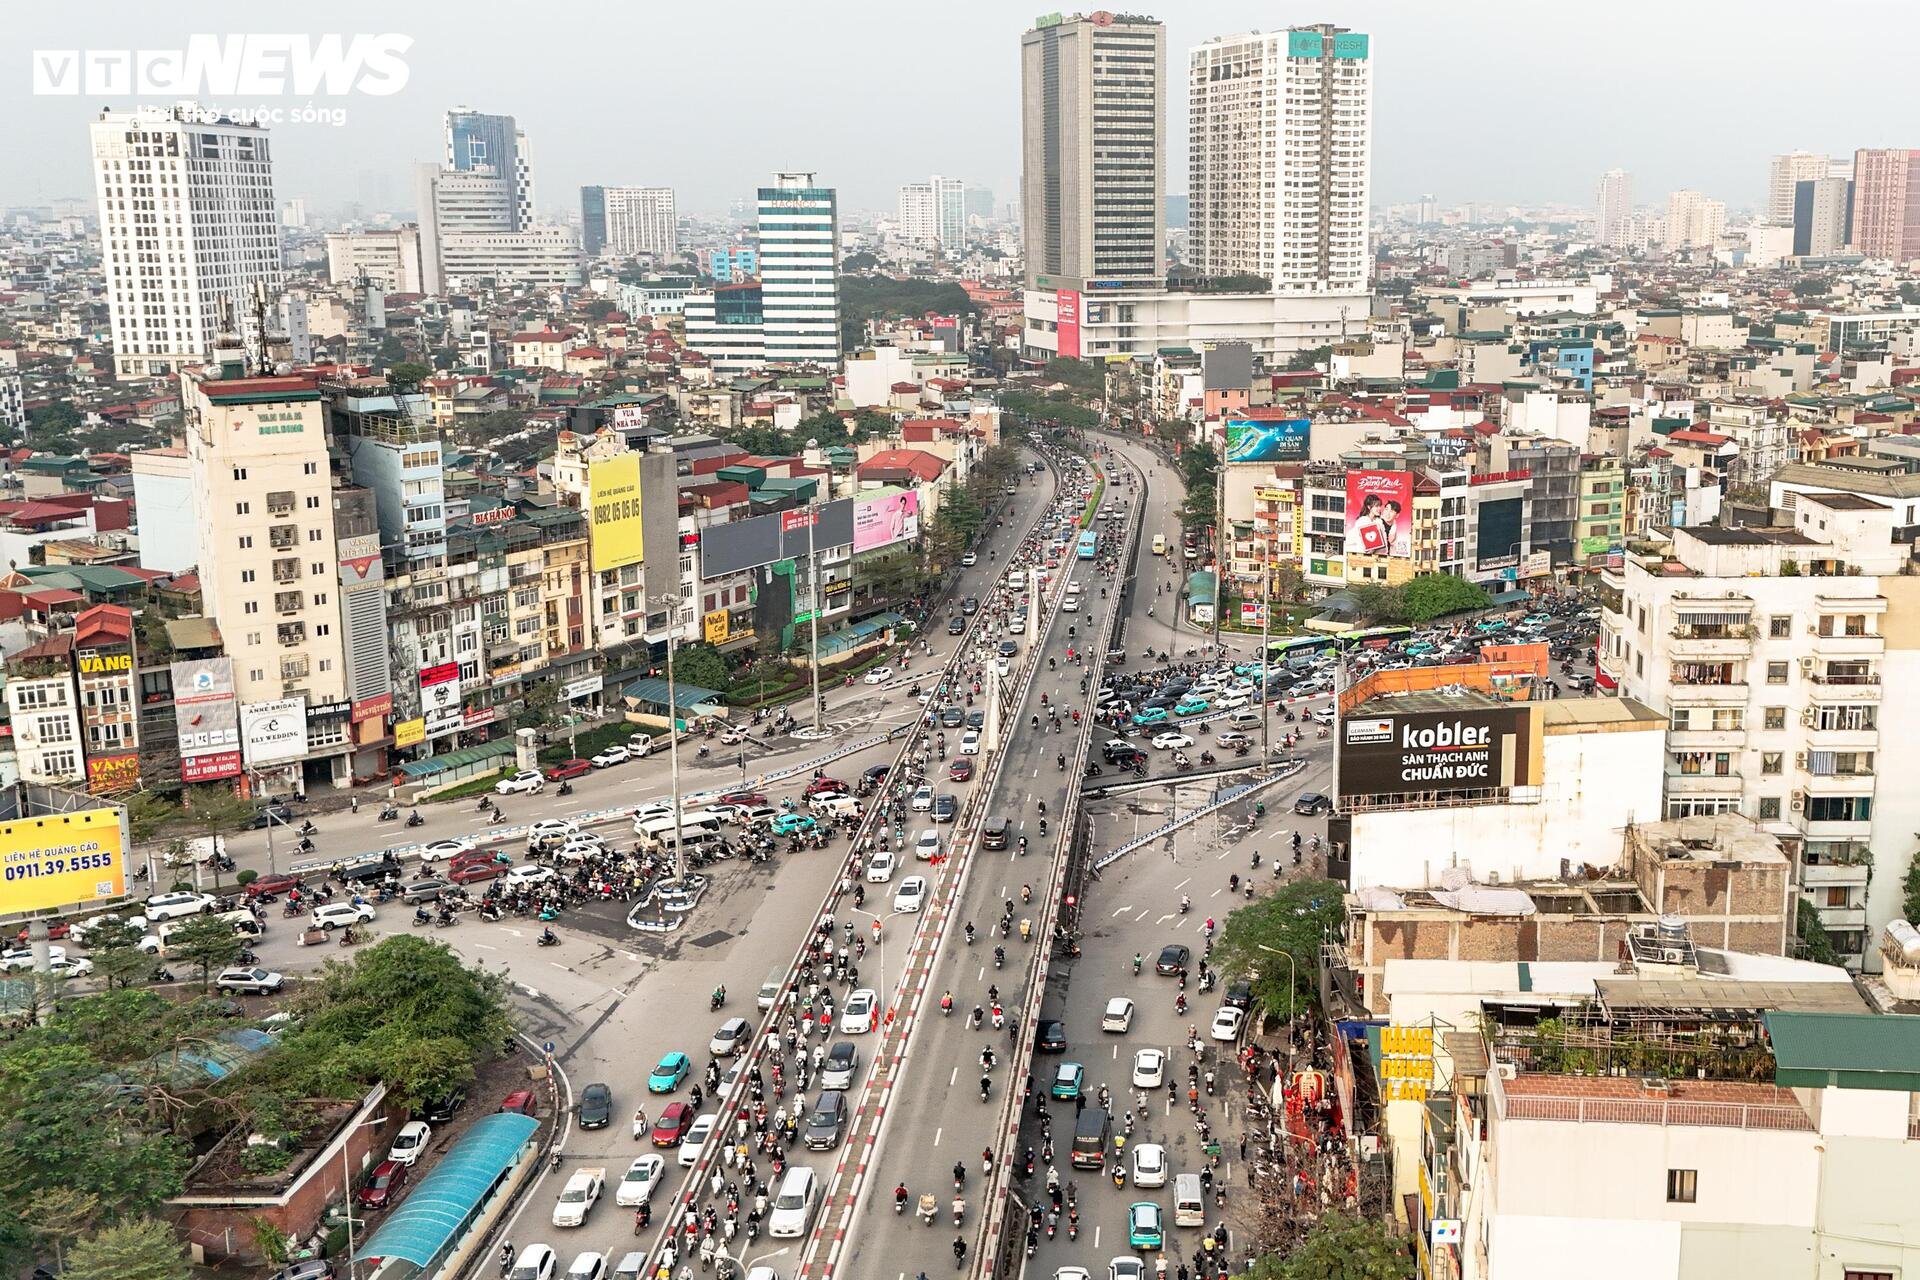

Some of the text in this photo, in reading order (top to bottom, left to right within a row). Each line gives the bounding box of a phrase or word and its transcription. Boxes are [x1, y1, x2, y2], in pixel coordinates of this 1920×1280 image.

[1432, 445, 1465, 456] LILY
[594, 498, 640, 525] 0982 05 05 05
[80, 654, 133, 673] VÀNG
[271, 702, 297, 711] BRIDAL
[266, 730, 299, 741] WEDDING
[1402, 751, 1489, 766] SÀN THẠCH ANH
[186, 766, 202, 777] MÁY
[1401, 762, 1488, 781] CHUẨN ĐỨC
[4, 851, 26, 863] LIÊN
[80, 841, 98, 852] CÁO
[5, 852, 112, 881] 0911.39.5555
